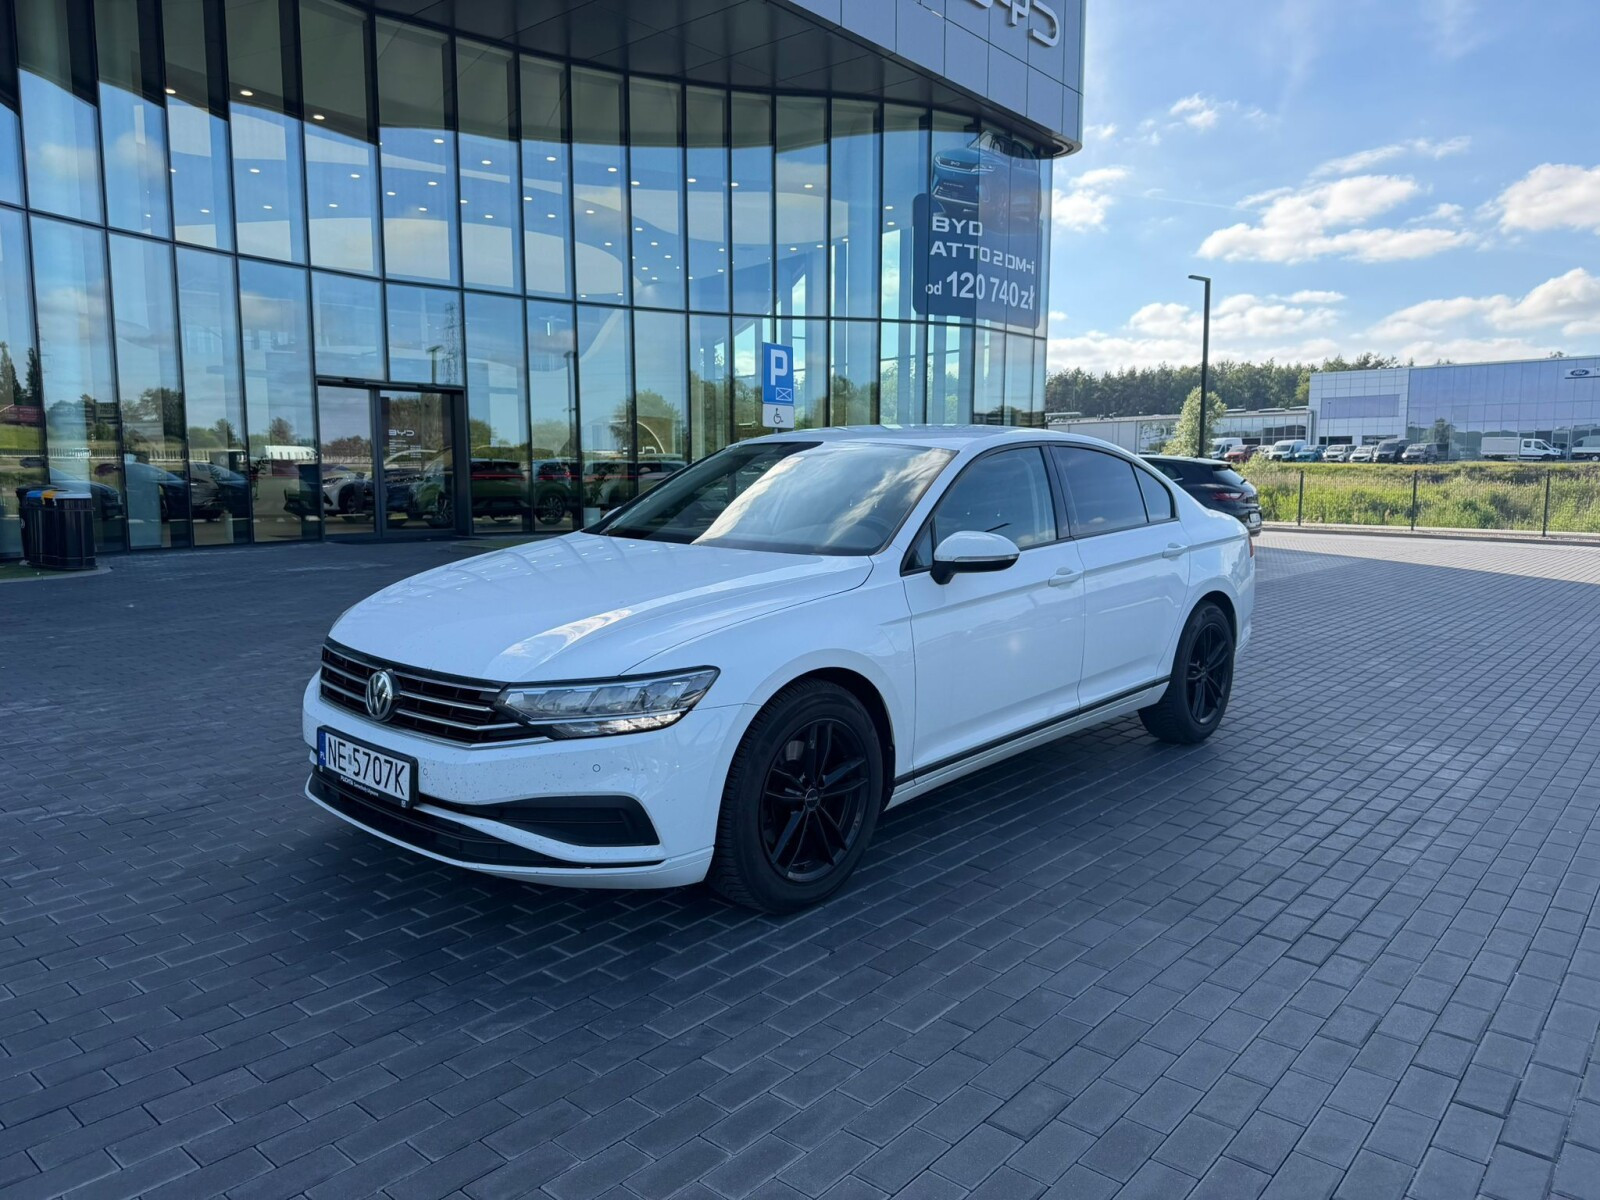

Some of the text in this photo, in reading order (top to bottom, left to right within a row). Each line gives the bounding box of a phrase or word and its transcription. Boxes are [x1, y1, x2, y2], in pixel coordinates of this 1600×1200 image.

[965, 0, 1060, 47] YD
[932, 216, 983, 236] BYD
[930, 240, 1035, 275] ATTO 2 DM-i
[925, 271, 1035, 310] od 120 740 zł
[770, 348, 788, 386] P
[388, 429, 415, 437] BYD
[328, 736, 347, 772] NE
[353, 747, 406, 797] 5707K
